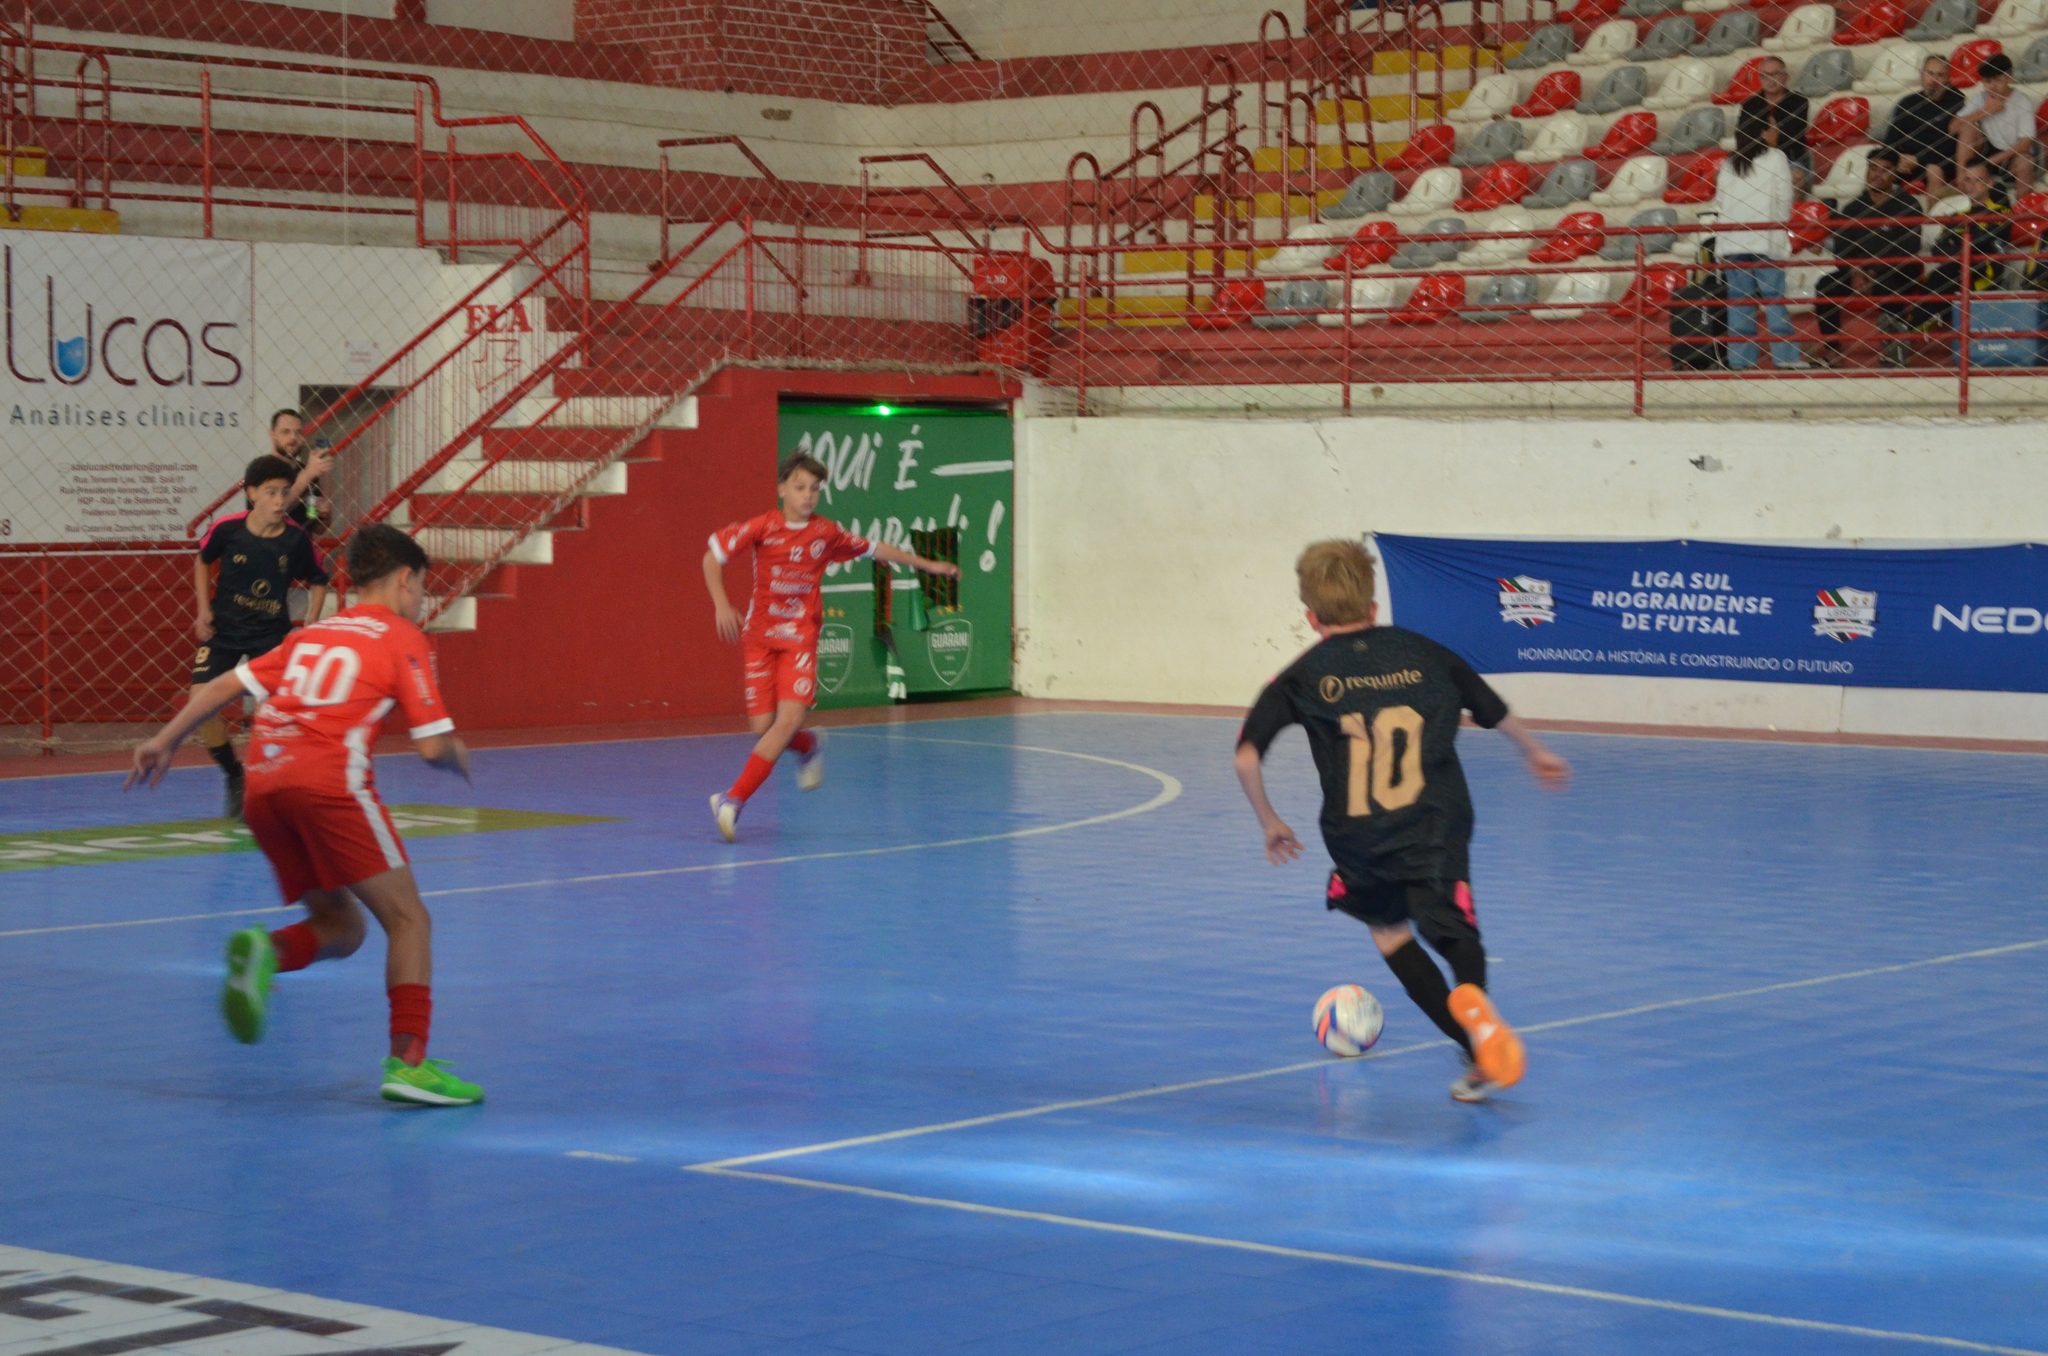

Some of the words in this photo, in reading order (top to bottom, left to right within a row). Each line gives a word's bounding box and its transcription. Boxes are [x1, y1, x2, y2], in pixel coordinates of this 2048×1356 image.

[10, 403, 128, 427] Análises
[894, 424, 924, 490] É
[1631, 571, 1685, 589] LIGA
[1689, 572, 1734, 592] SUL
[1592, 590, 1775, 615] RIOGRANDENSE
[1621, 613, 1651, 631] DE
[1655, 615, 1741, 636] FUTSAL
[1932, 603, 2048, 635] NED
[1518, 647, 1593, 663] HONRANDO
[1595, 648, 1607, 663] A
[1670, 651, 1678, 665] E
[1680, 653, 1780, 672] CONSTRUINDO
[1783, 658, 1796, 672] O
[1798, 658, 1854, 674] FUTURO
[277, 642, 362, 707] 50
[1346, 668, 1423, 690] requinte
[1339, 705, 1426, 818] 10
